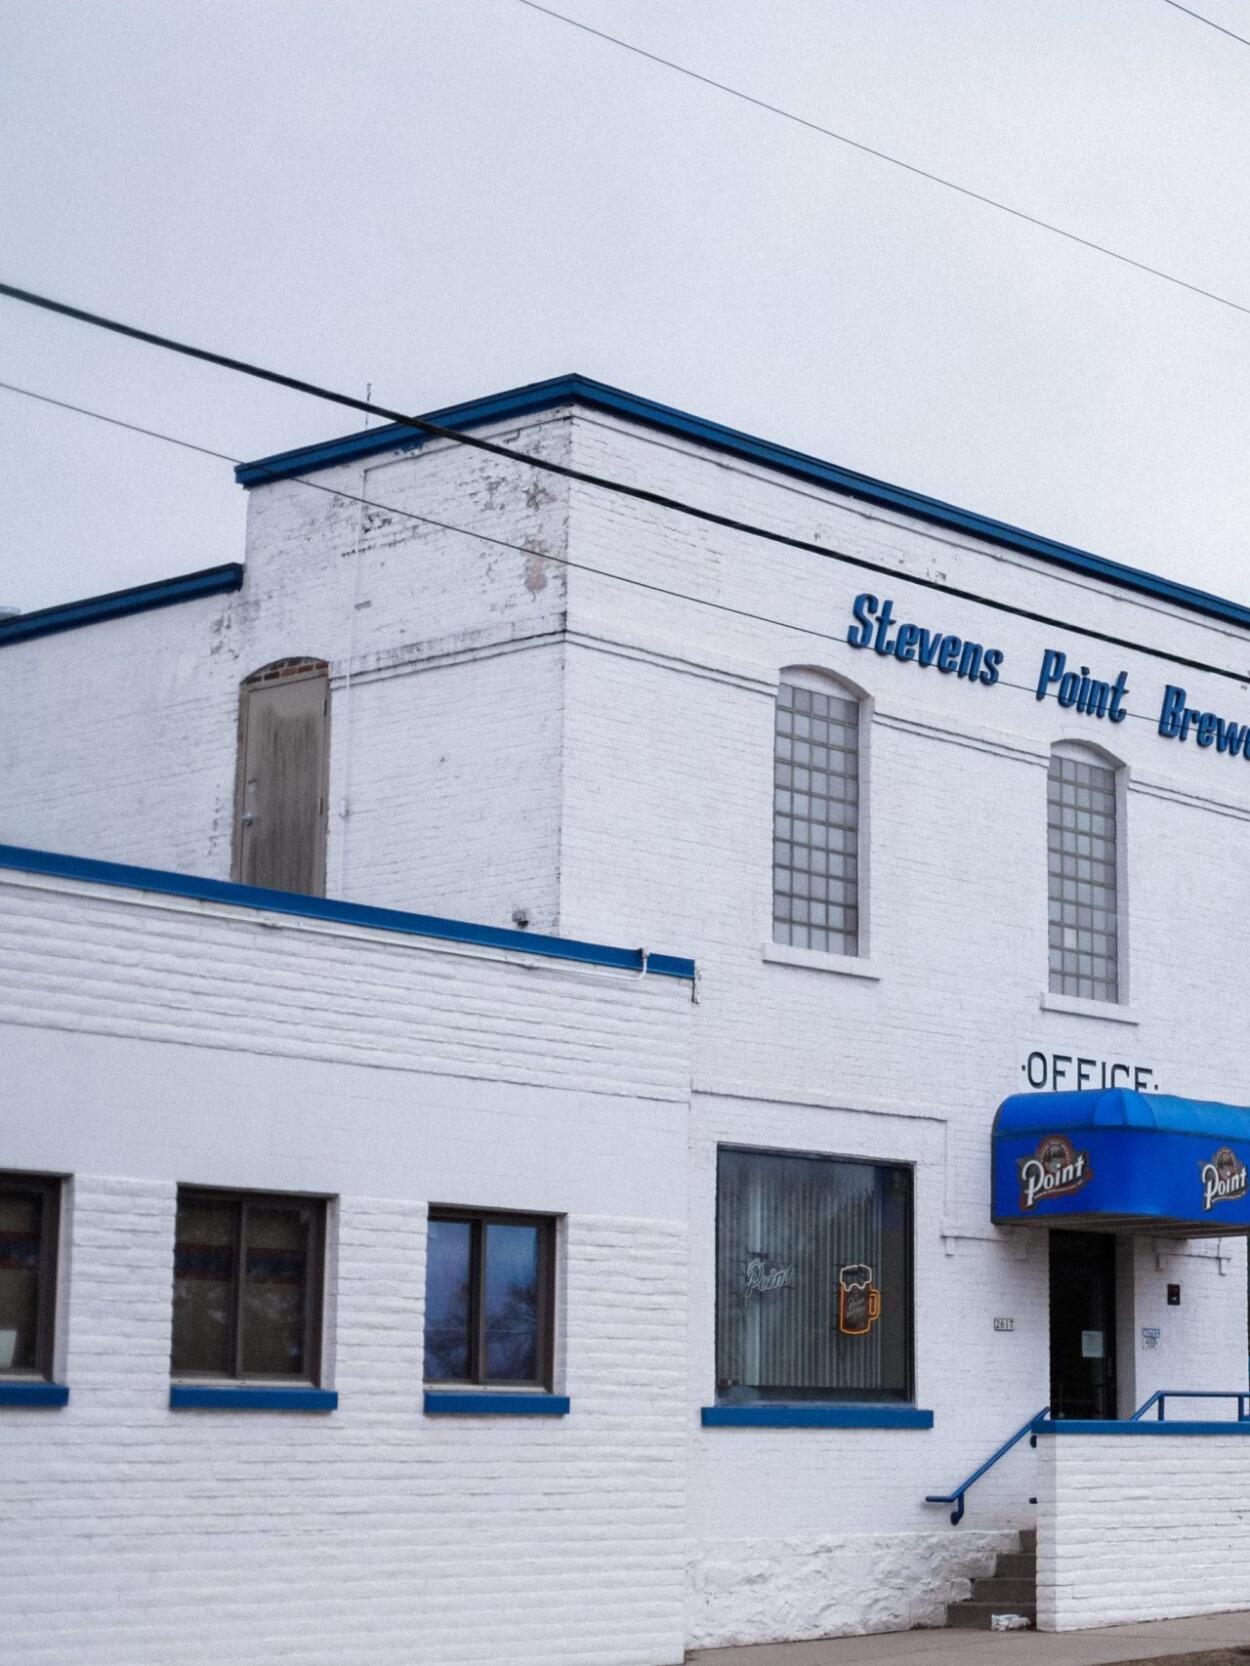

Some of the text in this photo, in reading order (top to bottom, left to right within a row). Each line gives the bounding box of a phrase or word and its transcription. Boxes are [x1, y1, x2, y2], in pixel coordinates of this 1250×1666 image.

[847, 593, 1004, 686] Stevens
[1036, 648, 1129, 723] Point
[1022, 1153, 1086, 1206] Point
[1202, 1164, 1247, 1210] Point
